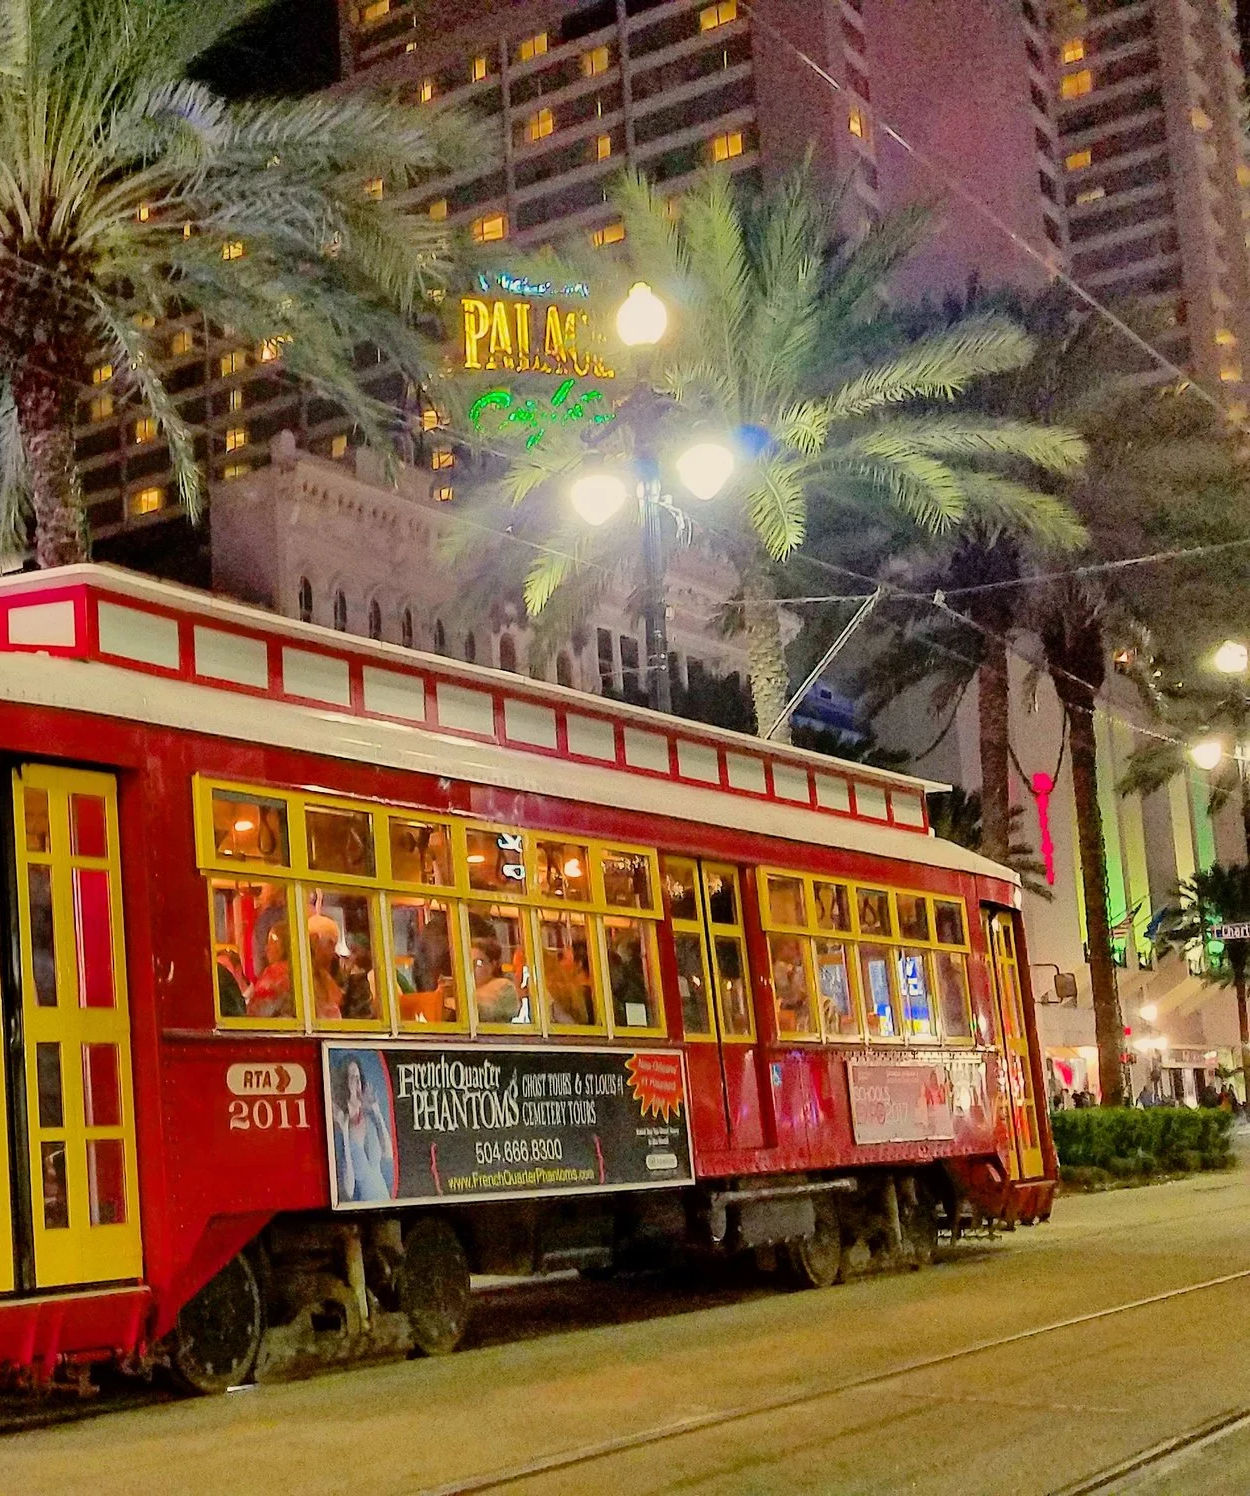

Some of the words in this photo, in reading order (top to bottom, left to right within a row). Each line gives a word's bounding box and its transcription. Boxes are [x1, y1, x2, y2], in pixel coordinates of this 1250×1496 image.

[461, 298, 615, 378] PALAC
[243, 1070, 272, 1089] RTA
[396, 1052, 450, 1099] French
[449, 1058, 501, 1094] Quarter
[228, 1098, 311, 1131] 2011
[412, 1084, 519, 1132] PHANTOMS
[522, 1101, 567, 1126] CEMETERY
[567, 1099, 596, 1125] TOURS
[475, 1138, 563, 1164] 504.666.8300
